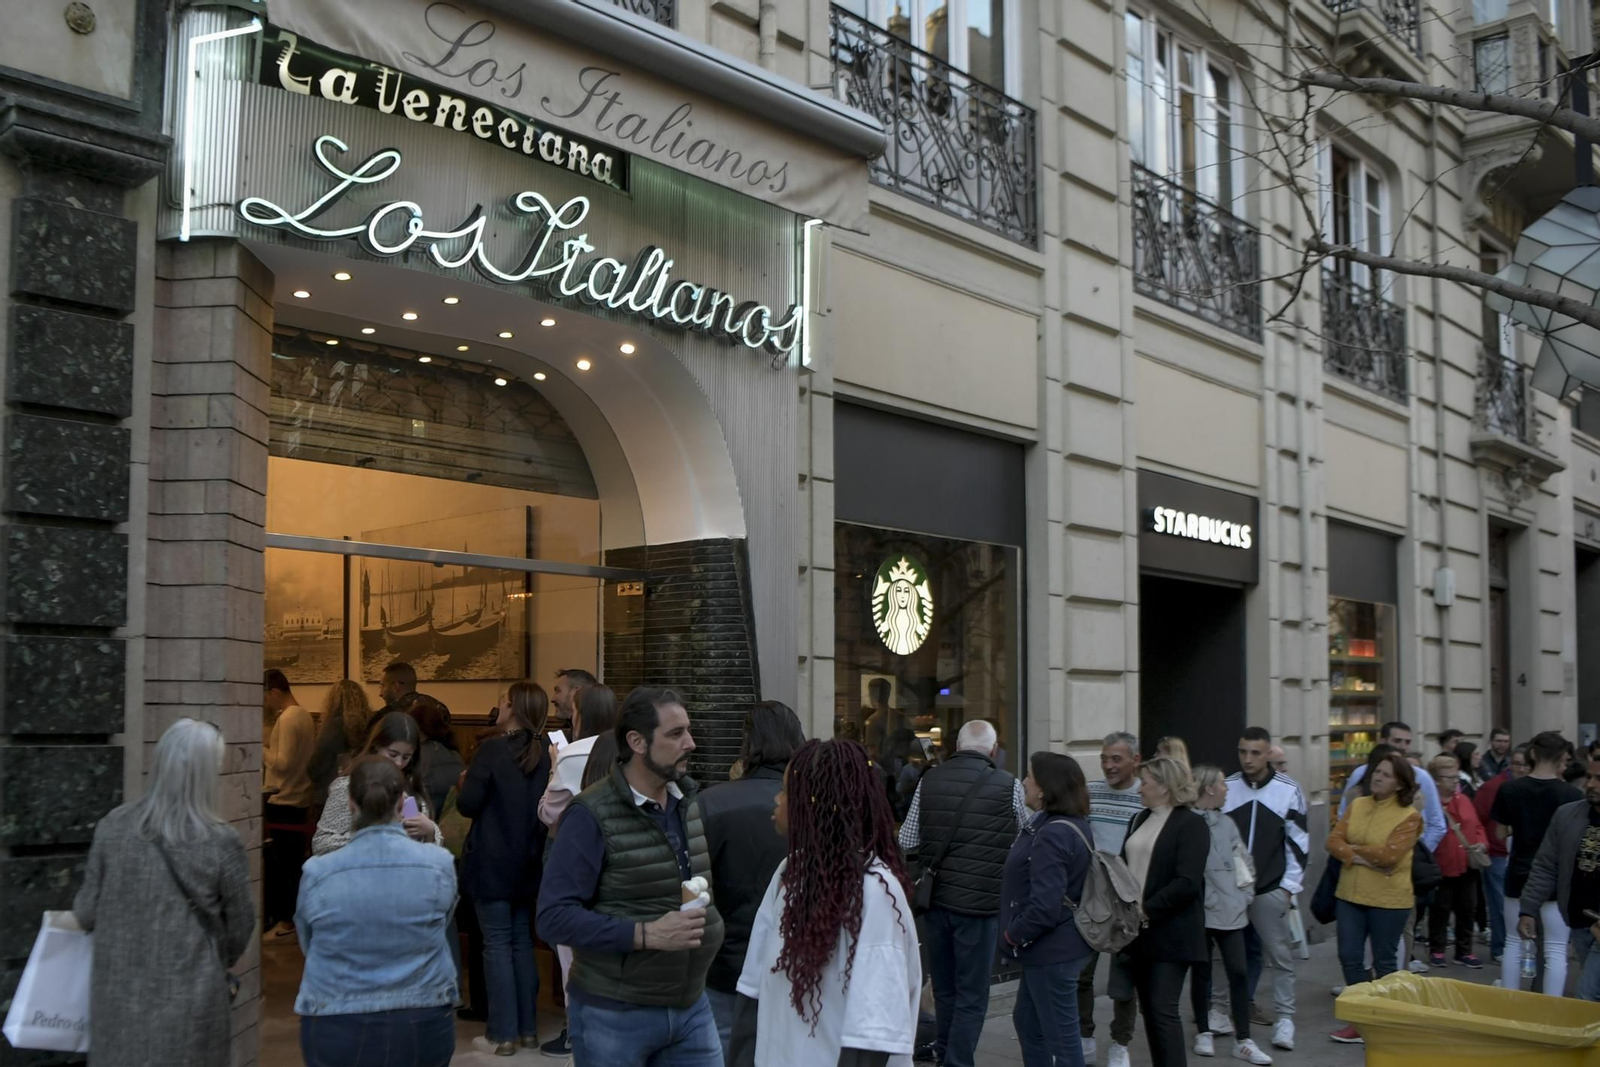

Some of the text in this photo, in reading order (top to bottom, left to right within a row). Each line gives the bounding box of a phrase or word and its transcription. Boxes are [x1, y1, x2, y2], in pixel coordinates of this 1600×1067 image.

[276, 30, 614, 185] La Veneciana
[402, 2, 788, 193] Los Italianos
[239, 135, 803, 349] Los Italianos
[1153, 506, 1252, 549] STARBUCKS
[31, 1010, 71, 1030] Pedro
